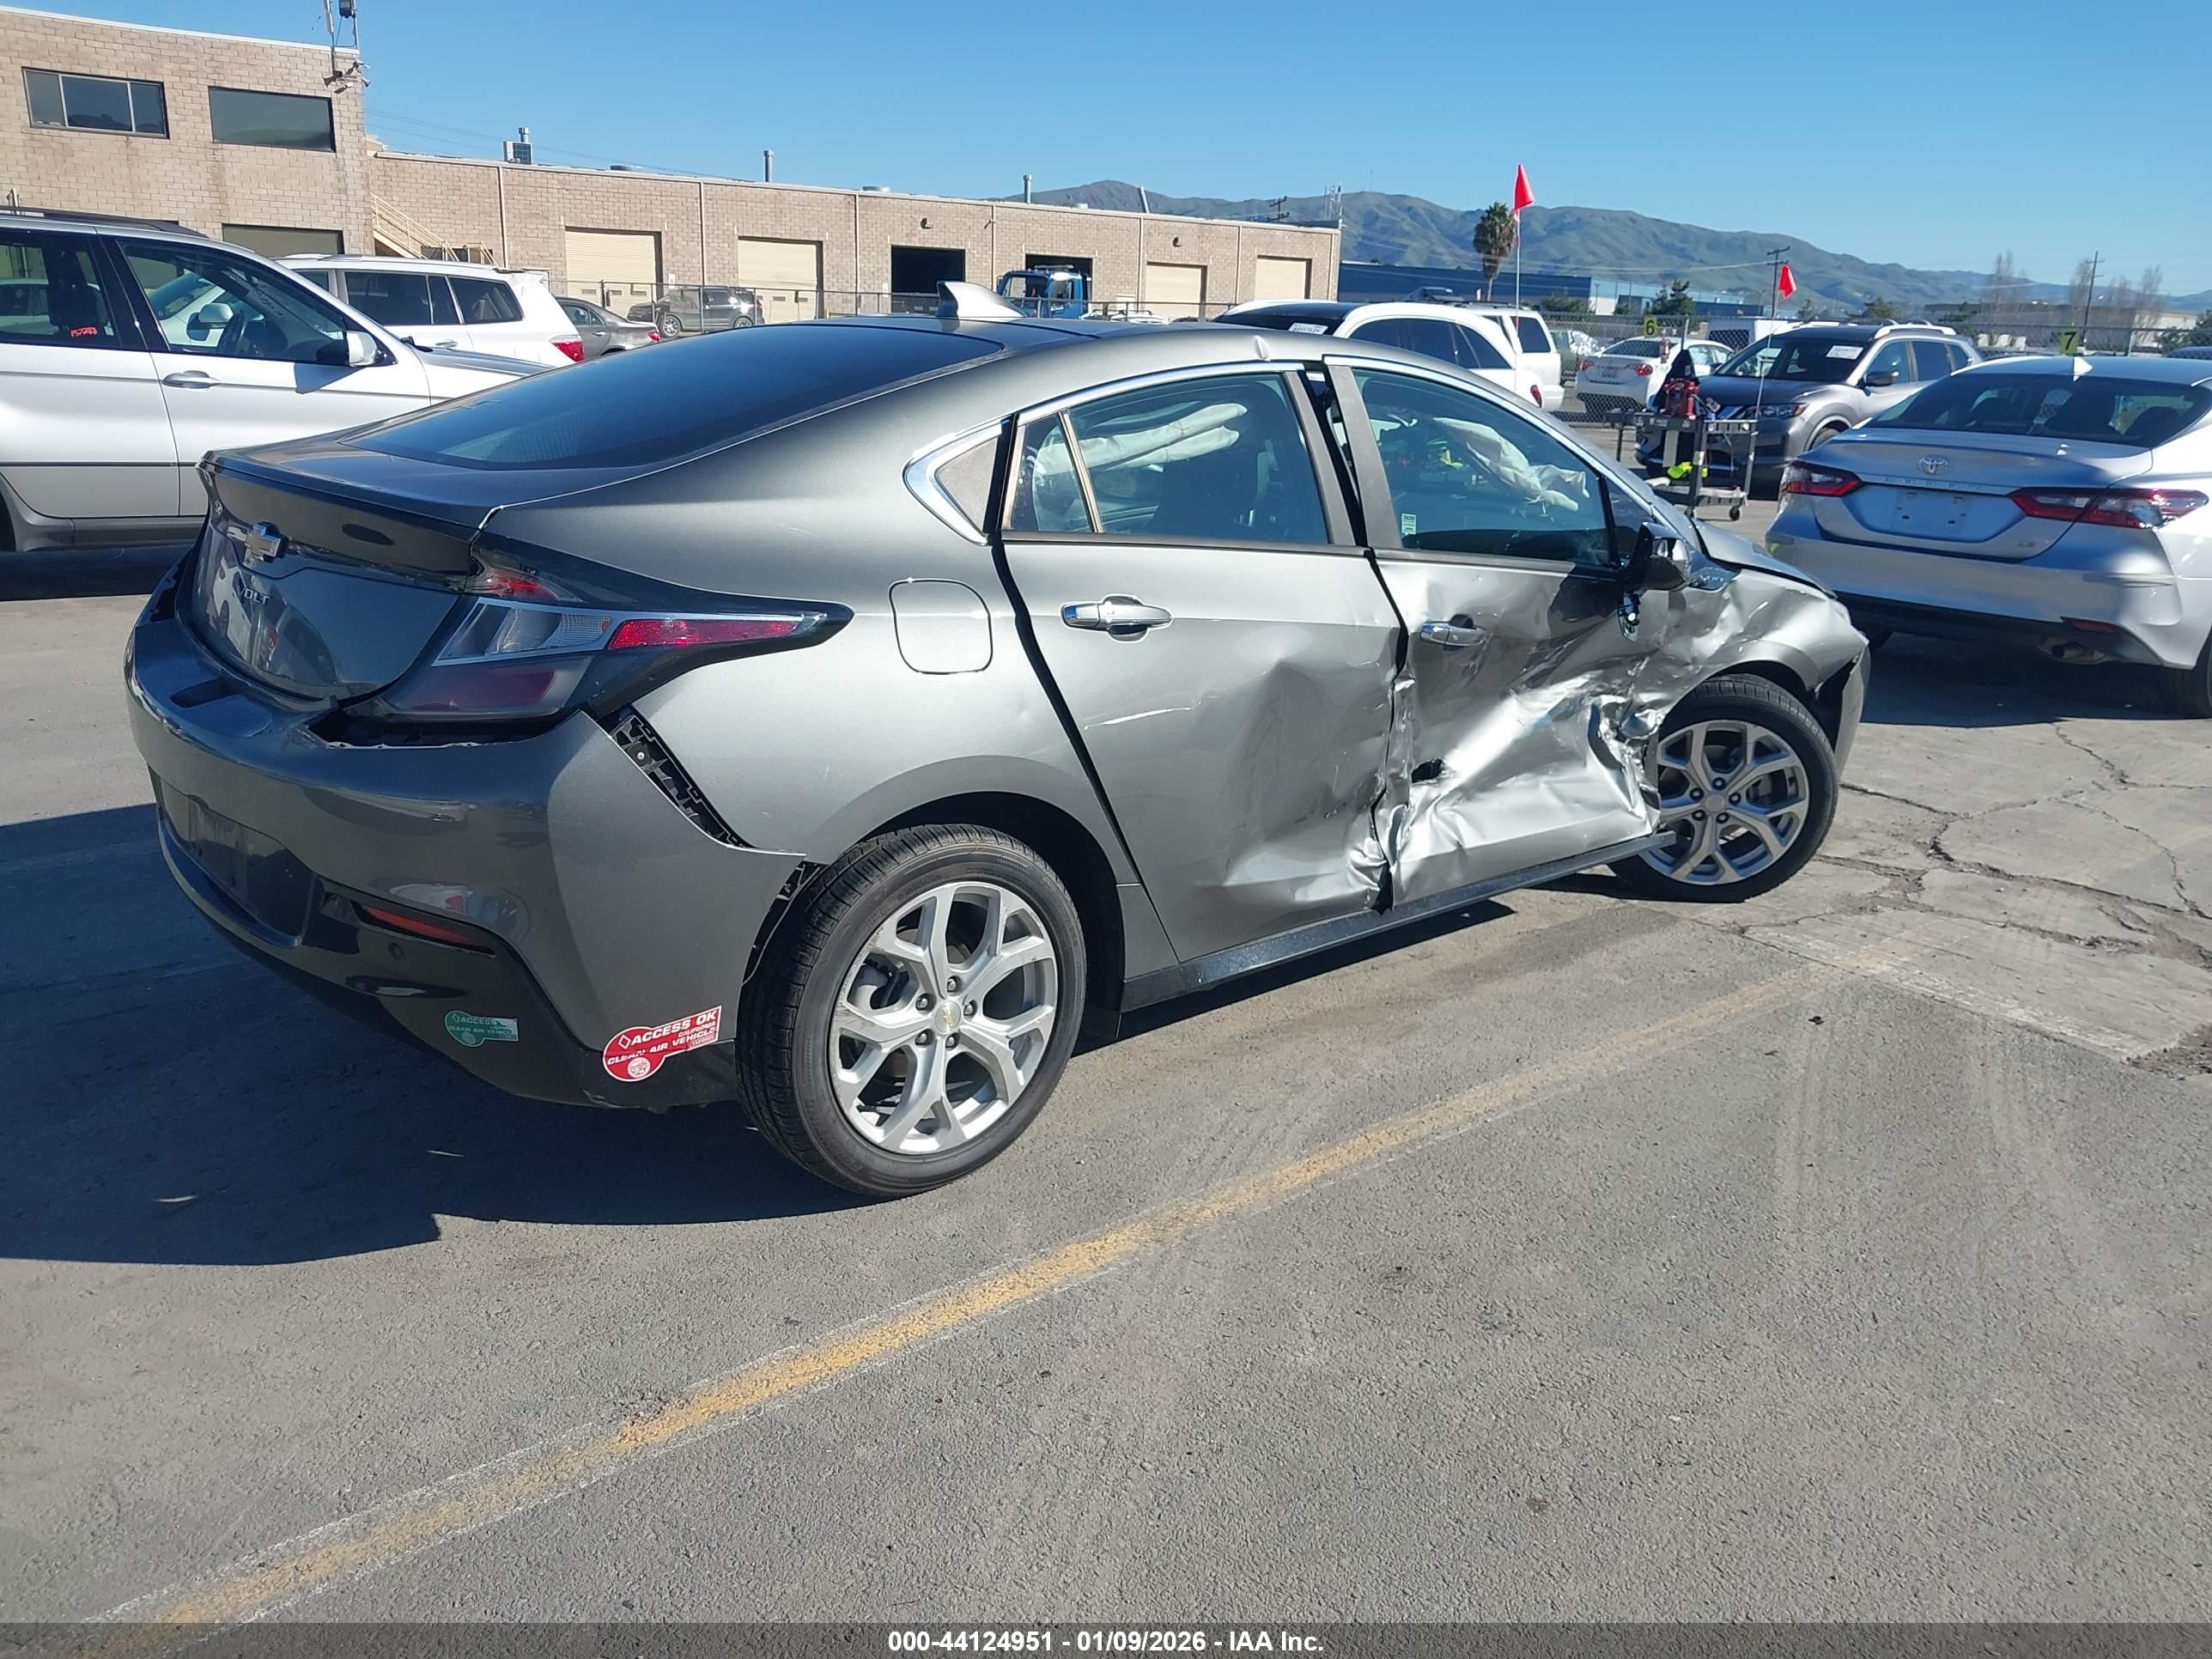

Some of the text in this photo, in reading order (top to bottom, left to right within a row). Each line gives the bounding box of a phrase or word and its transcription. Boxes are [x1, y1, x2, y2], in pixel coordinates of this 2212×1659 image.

[1646, 319, 1655, 336] 6
[2063, 331, 2076, 350] 7
[237, 585, 270, 605] VOLT
[460, 1017, 498, 1025] ACCESS
[631, 1019, 690, 1046] ACCESS
[696, 1011, 717, 1024] OK
[649, 1042, 669, 1053] AIR
[672, 1026, 716, 1047] VEHICLE
